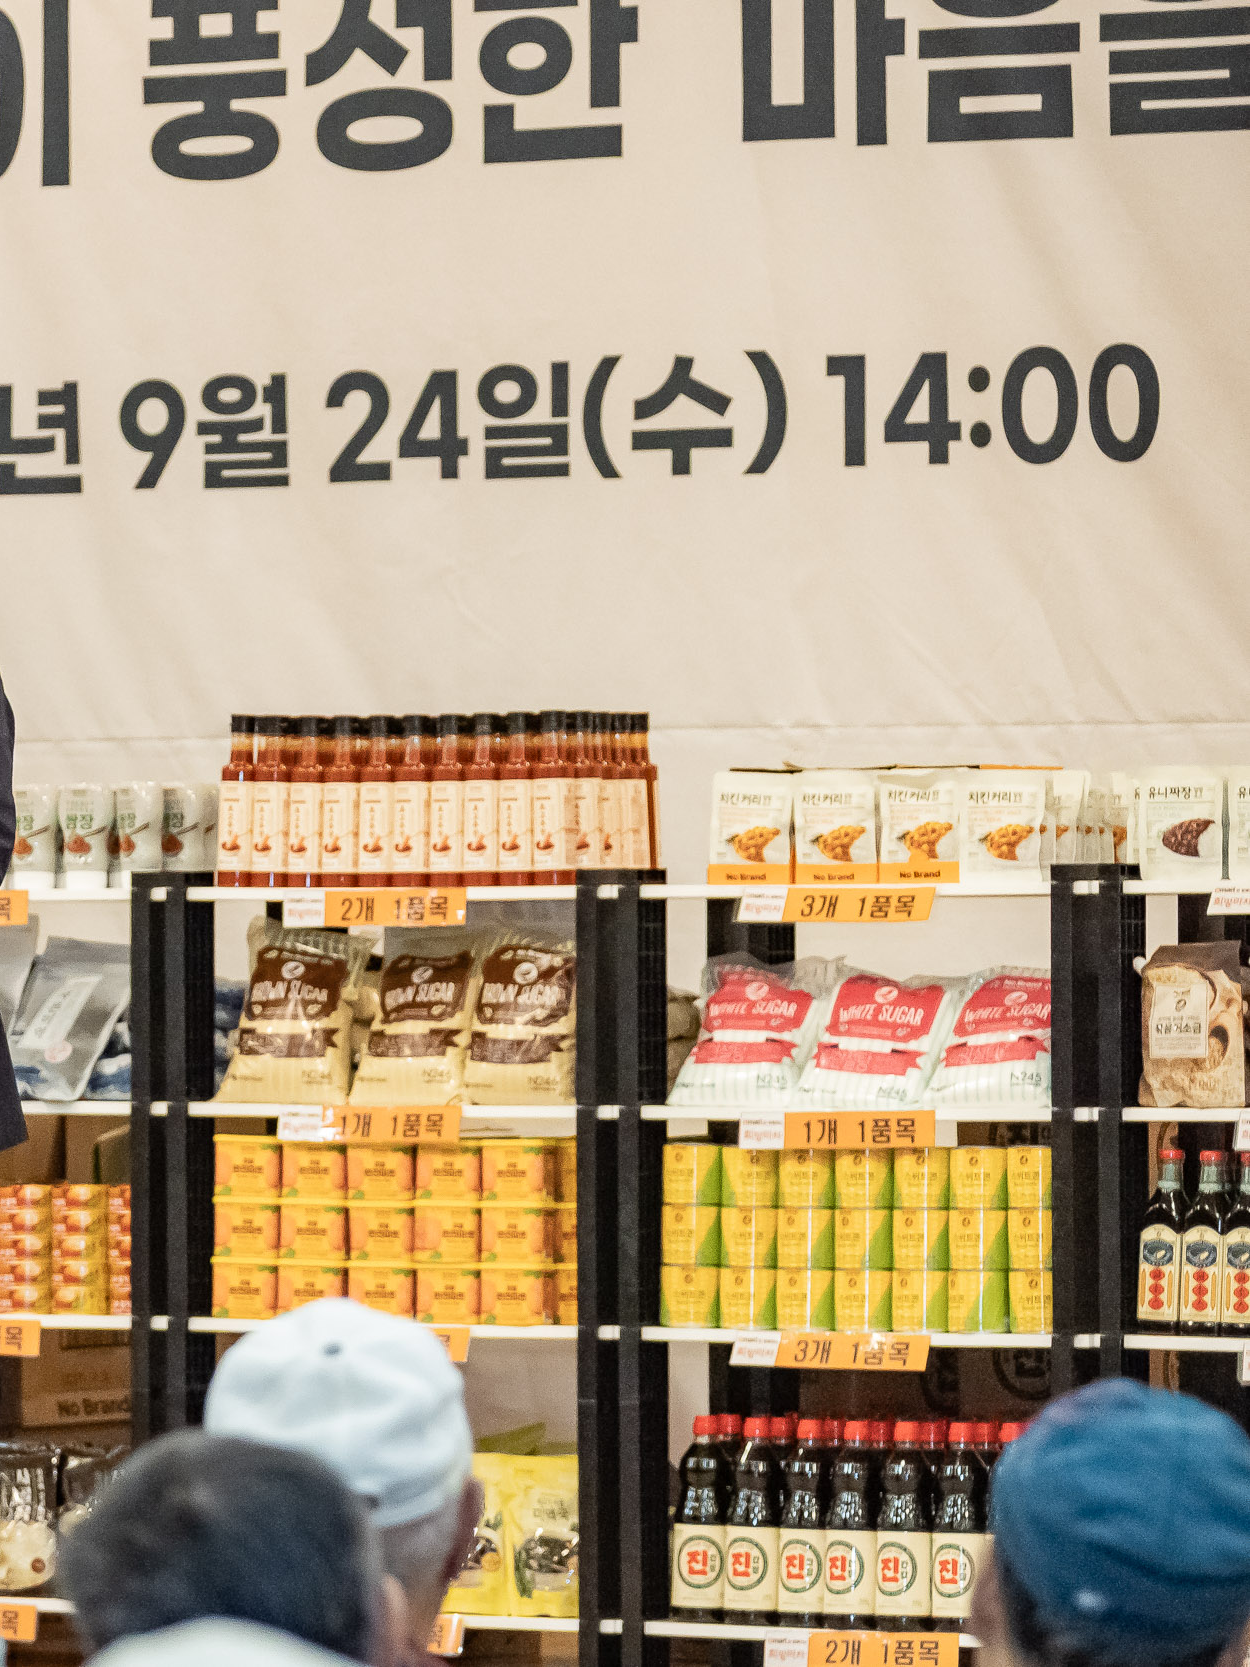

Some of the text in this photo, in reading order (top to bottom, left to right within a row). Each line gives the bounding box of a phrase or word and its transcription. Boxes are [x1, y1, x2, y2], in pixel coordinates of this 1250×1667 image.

[143, 0, 639, 181] 풍성한
[119, 373, 290, 490] 9월
[326, 350, 788, 483] 24일(수)
[826, 343, 1161, 467] 14:00
[913, 869, 941, 879] Brand
[341, 897, 375, 922] 2개
[394, 896, 448, 921] 1품목
[801, 894, 916, 918] 3개 1품목
[709, 999, 798, 1017] WHITE SUGAR
[839, 1003, 925, 1026] WHITE SUGAR
[964, 1002, 1051, 1023] WHITE SUGAR
[341, 1113, 372, 1138] 1개
[391, 1113, 444, 1138] 1품목
[804, 1118, 916, 1144] 1개 1품목
[794, 1340, 910, 1366] 3개 1품목
[686, 1549, 708, 1576] 진
[731, 1552, 751, 1578] 진
[785, 1553, 805, 1580] 진
[828, 1555, 847, 1582] 진
[880, 1556, 900, 1583] 진
[938, 1558, 959, 1585] 진
[825, 1639, 939, 1666] 2개 1품목
